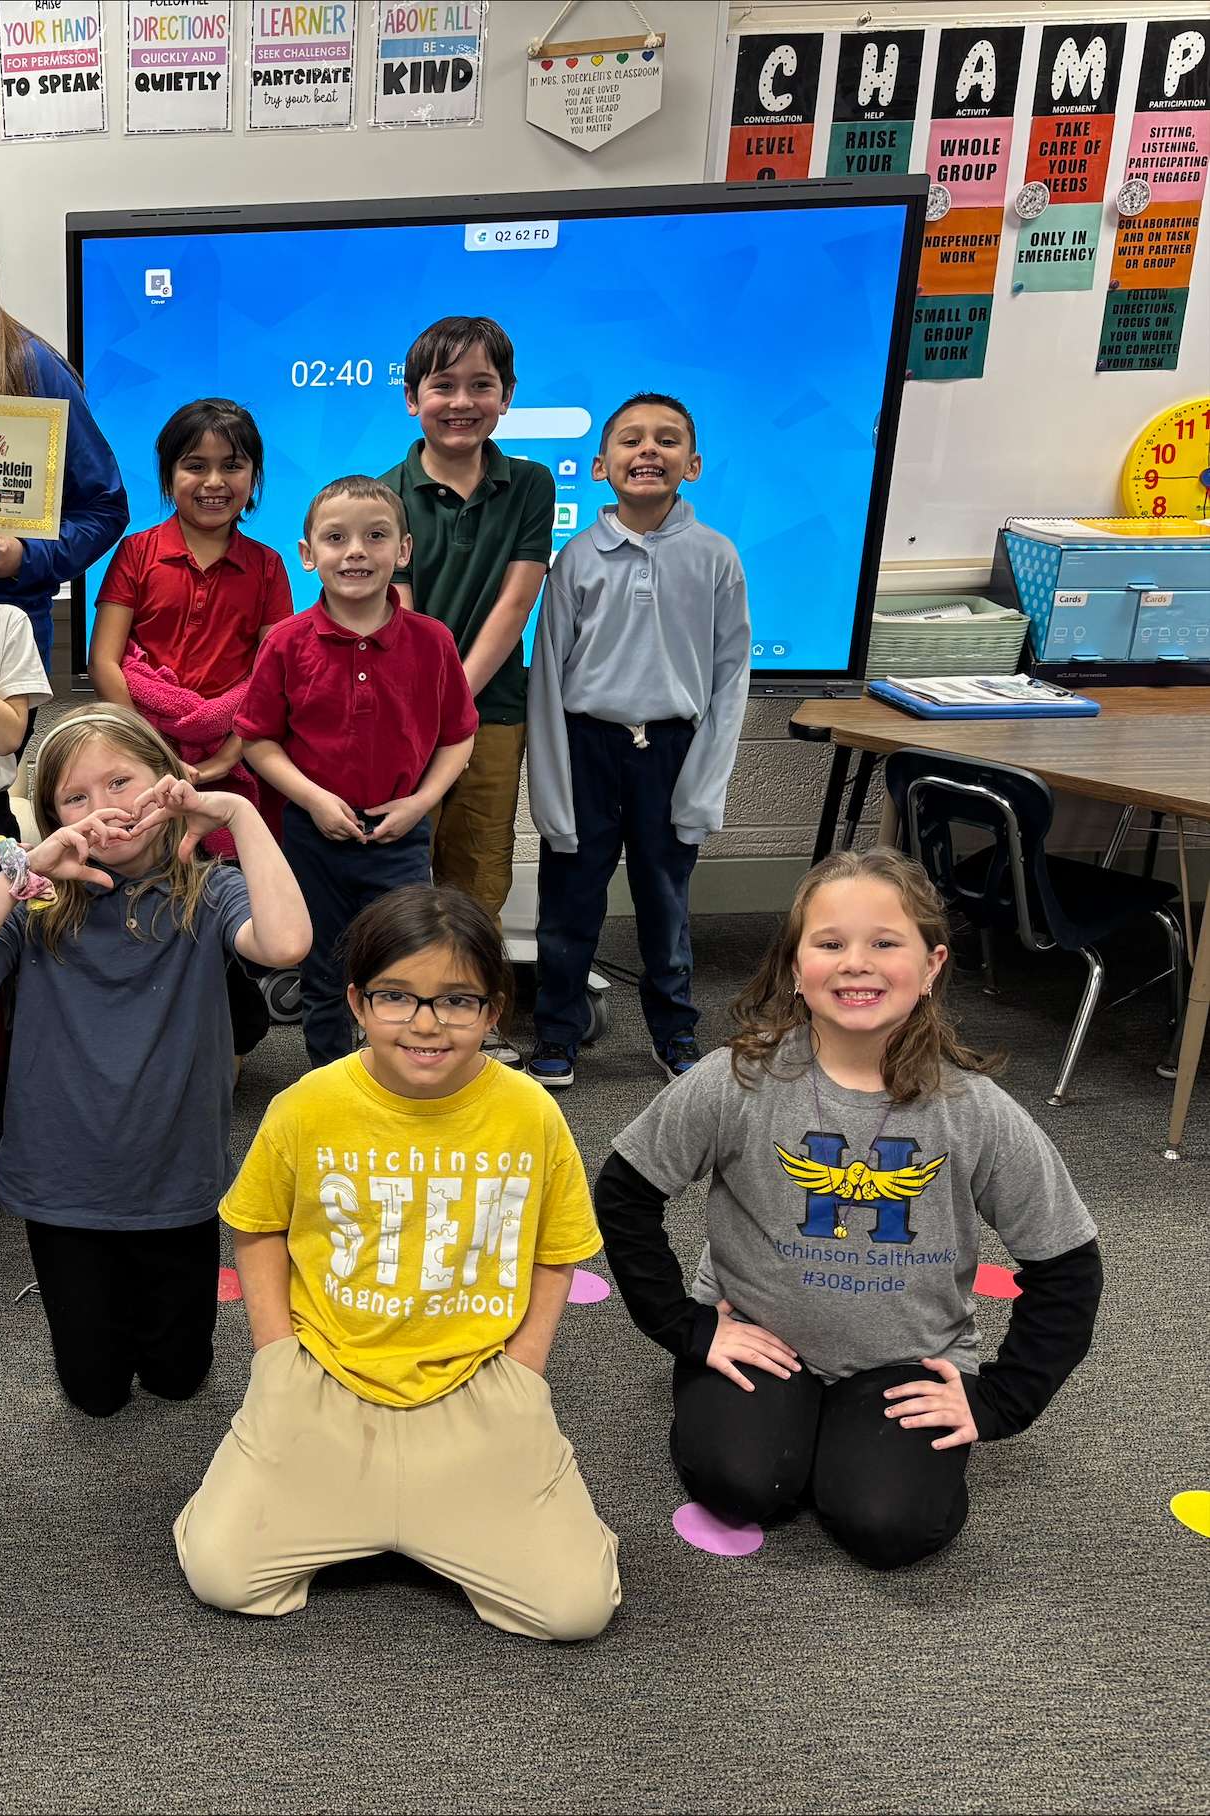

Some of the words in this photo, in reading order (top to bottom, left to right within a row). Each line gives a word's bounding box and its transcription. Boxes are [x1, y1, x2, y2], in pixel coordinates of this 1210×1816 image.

[133, 15, 226, 41] DIRECTIONS
[260, 4, 346, 37] LEARNER
[384, 8, 438, 34] ABOVE
[444, 5, 472, 30] ALL
[4, 21, 47, 47] YOUR
[53, 16, 97, 43] HAND
[258, 49, 283, 59] SEEK
[286, 46, 346, 58] CHALLENGES
[423, 42, 436, 52] BE
[141, 52, 188, 63] QUICKLY
[192, 51, 216, 62] AND
[1164, 30, 1205, 97] P
[383, 58, 473, 95] KIND
[615, 67, 659, 79] CLASSROOM
[858, 43, 899, 107] H
[955, 40, 995, 102] A
[1051, 37, 1106, 100] M
[3, 77, 29, 97] TO
[39, 73, 100, 94] SPEAK
[135, 71, 221, 92] QUIETLY
[758, 45, 797, 112] C
[264, 93, 281, 108] try
[285, 92, 311, 108] your
[314, 88, 338, 104] best
[567, 88, 579, 96] YOU
[582, 87, 595, 95] ARE
[598, 84, 619, 93] LOVED
[1053, 105, 1096, 113] MOVEMENT
[1149, 100, 1206, 108] PARTICIPATION
[744, 115, 802, 124] CONVERSATION
[1055, 122, 1090, 137] TAKE
[1150, 127, 1195, 138] SITTING,
[746, 137, 794, 155] LEVEL
[846, 131, 897, 149] RAISE
[940, 138, 1001, 157] WHOLE
[1039, 142, 1081, 156] CARE
[1084, 140, 1101, 154] OF
[1142, 142, 1198, 153] LISTENING,
[846, 155, 891, 172] YOUR
[1049, 159, 1087, 174] YOUR
[1129, 156, 1208, 168] PARTICIPATING
[937, 163, 997, 182] GROUP
[1042, 178, 1088, 192] NEEDS
[1119, 217, 1198, 229] COLLABORATING
[495, 230, 512, 243] Q2
[515, 229, 530, 242] 62
[534, 228, 549, 240] FD
[1030, 231, 1064, 246] ONLY
[1072, 231, 1087, 244] IN
[940, 252, 976, 264] WORK
[1018, 248, 1095, 263] EMERGENCY
[914, 308, 960, 323] SMALL
[968, 308, 987, 320] OR
[924, 327, 973, 341] GROUP
[292, 360, 373, 387] 02:40
[1175, 419, 1194, 439] 11
[1151, 444, 1175, 464] 10
[3, 477, 32, 489] School
[1145, 469, 1158, 490] 9
[317, 1147, 532, 1172] Hutchinson
[319, 1172, 530, 1290] STEM
[803, 1271, 906, 1294] #308pride
[325, 1273, 413, 1318] Magnet
[424, 1290, 514, 1318] School
